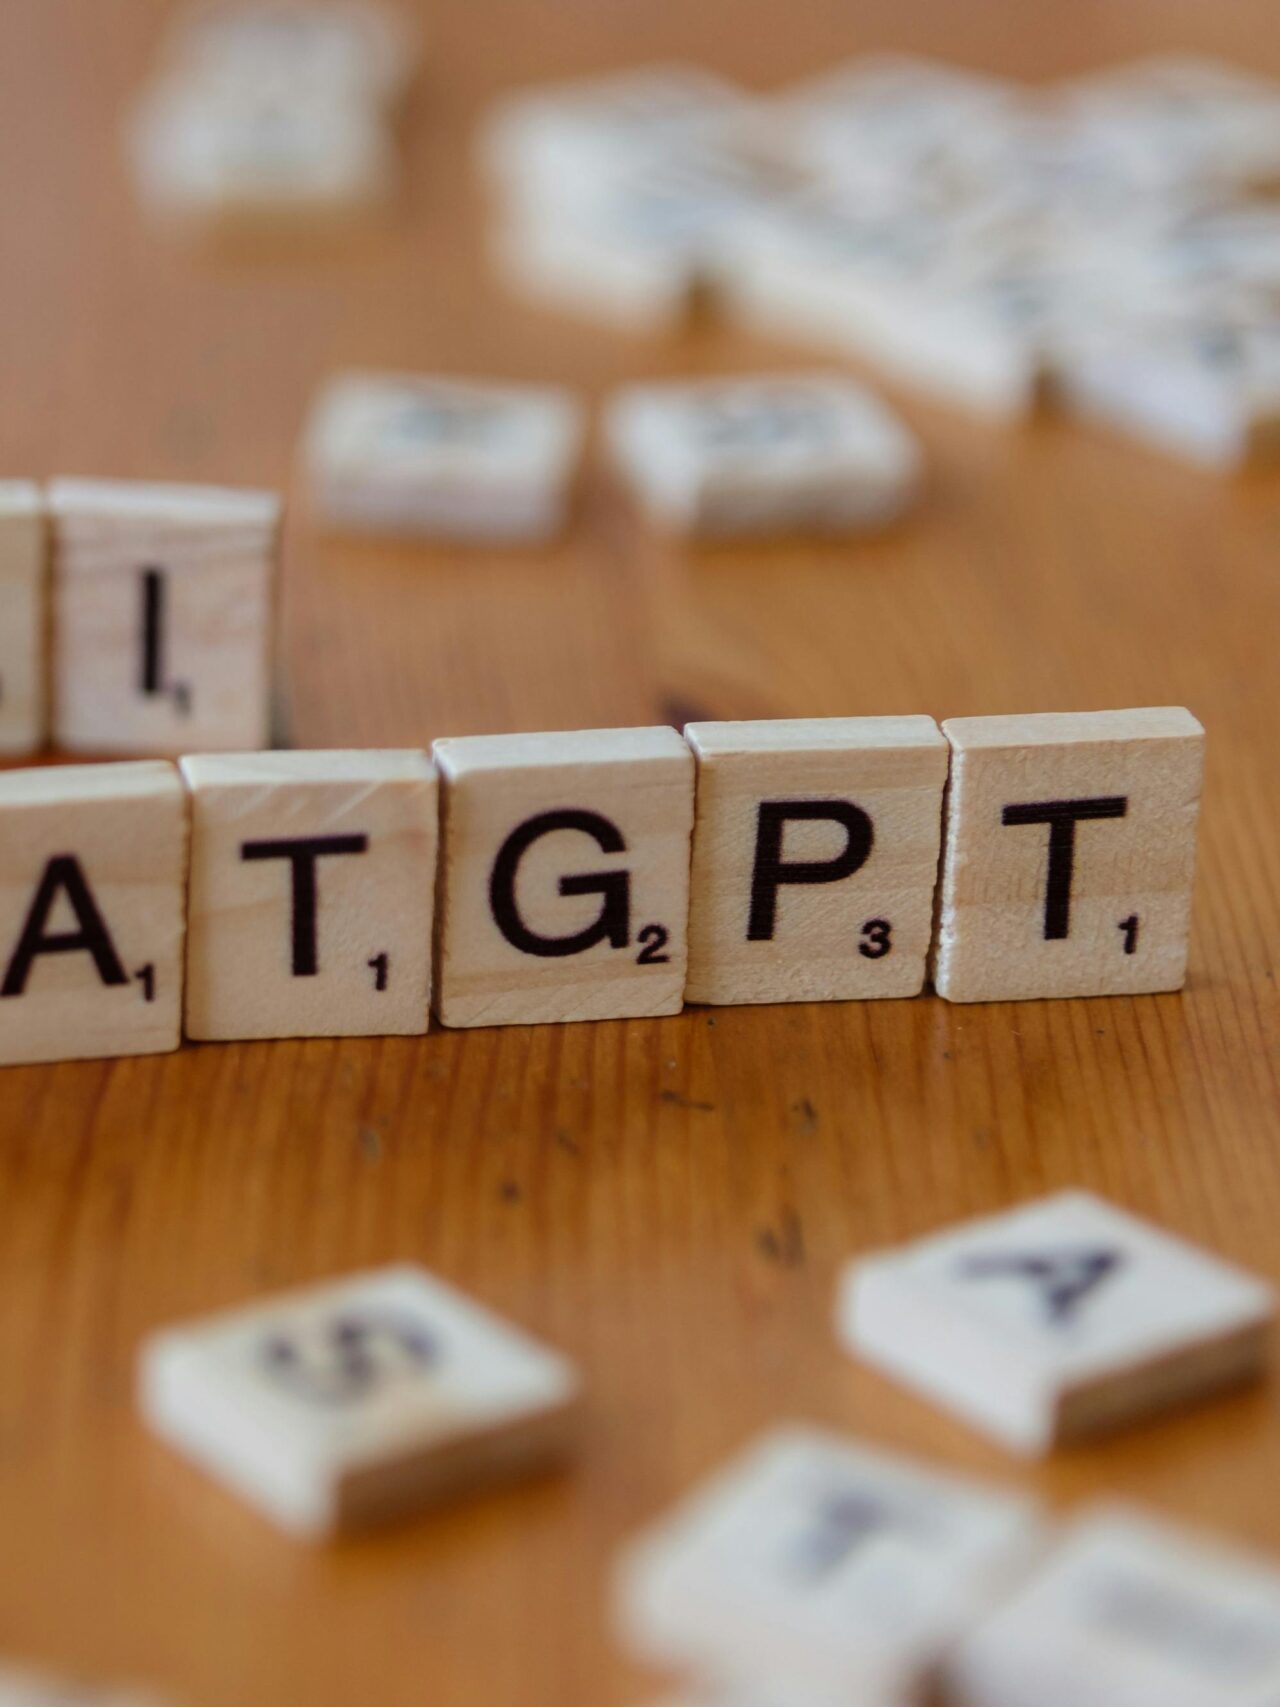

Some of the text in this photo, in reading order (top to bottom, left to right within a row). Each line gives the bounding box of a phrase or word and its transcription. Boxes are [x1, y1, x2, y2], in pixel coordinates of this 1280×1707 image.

[133, 961, 157, 1003] 1
[366, 951, 390, 993] 1
[634, 923, 671, 966] 2
[856, 918, 893, 960] 3
[1116, 914, 1140, 956] 1
